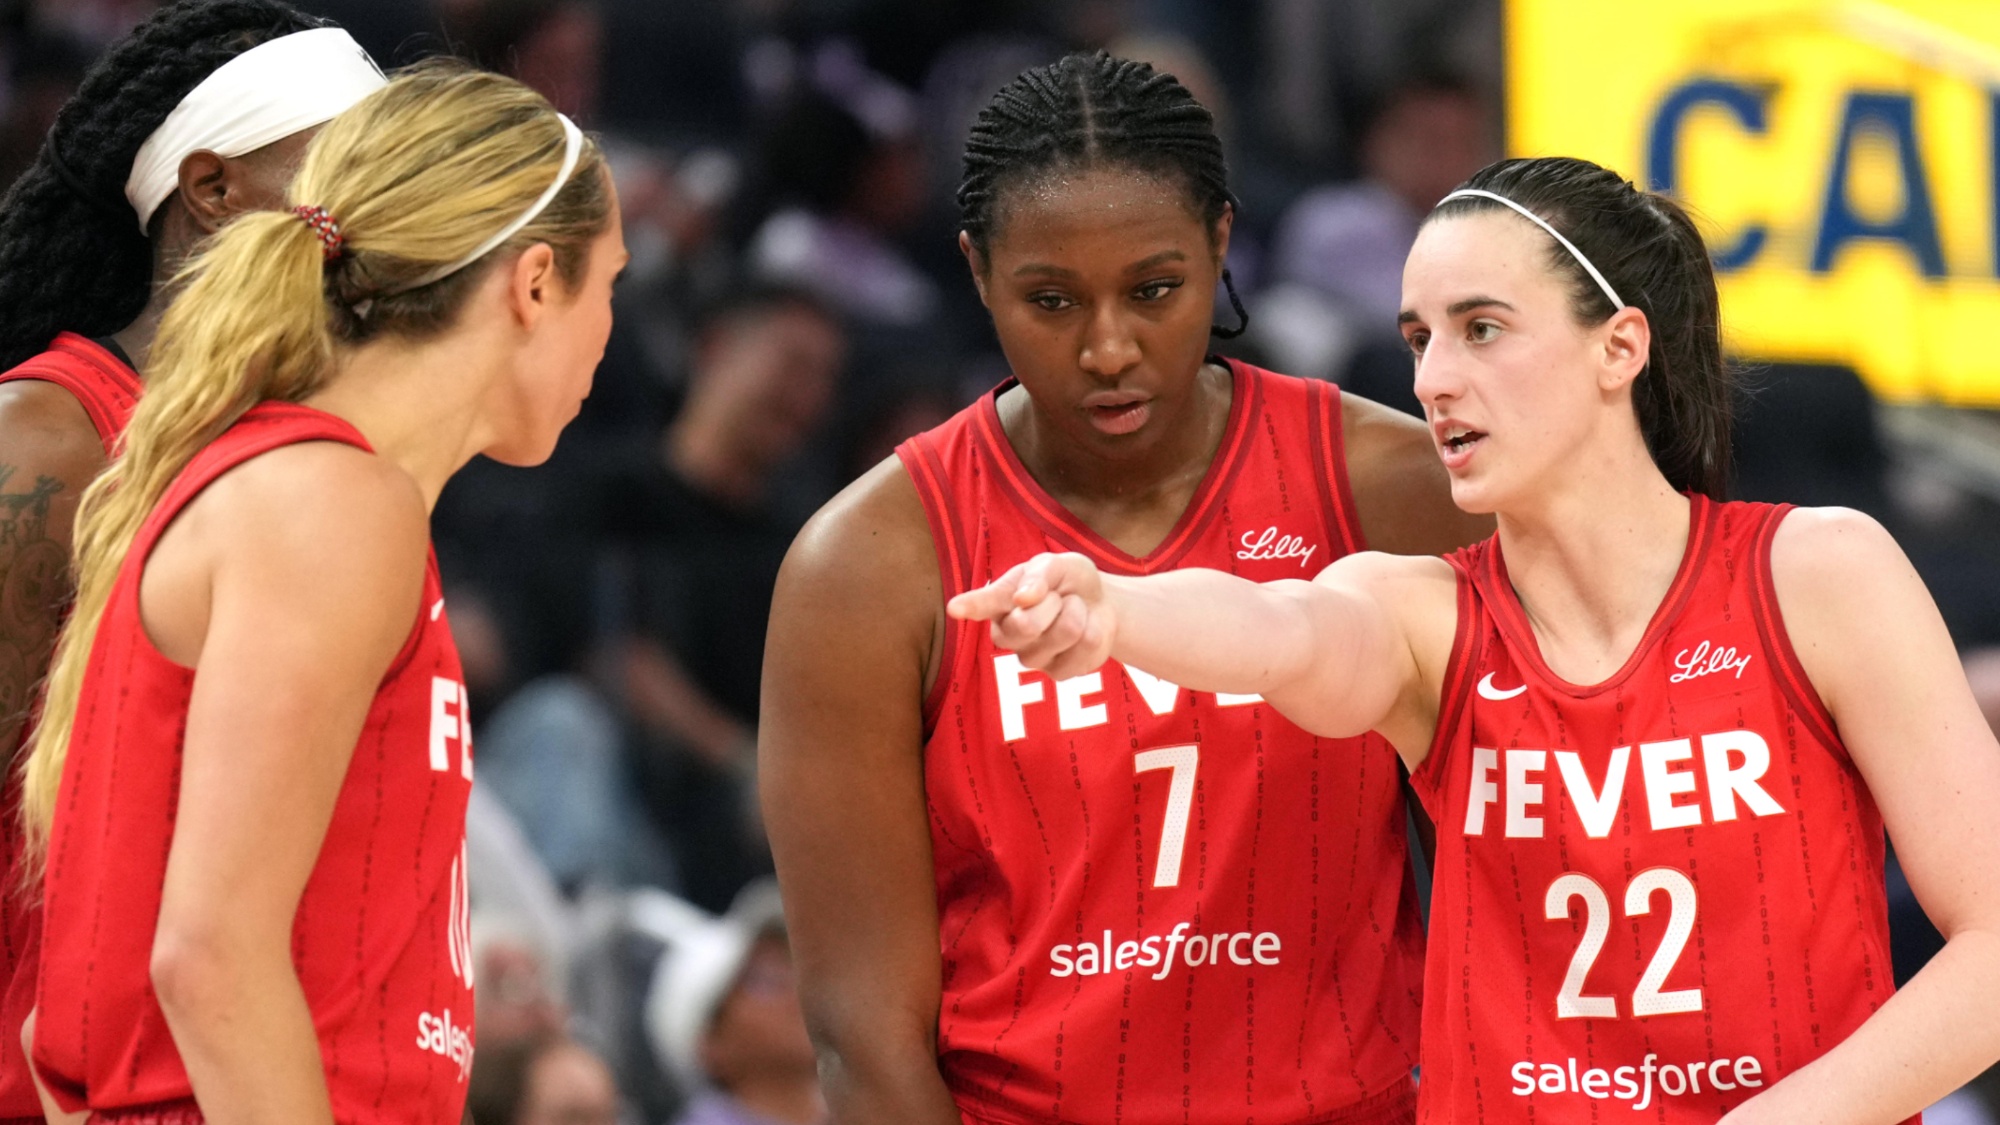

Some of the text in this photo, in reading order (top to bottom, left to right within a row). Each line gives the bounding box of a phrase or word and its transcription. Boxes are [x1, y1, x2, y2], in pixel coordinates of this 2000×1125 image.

[1649, 78, 2000, 278] CA
[1236, 526, 1317, 567] Lilly
[1669, 640, 1752, 683] Lilly
[993, 654, 1266, 742] FEV
[1310, 770, 1319, 822] 2020
[1463, 729, 1786, 840] FEVER
[1134, 744, 1200, 889] 7
[1310, 834, 1320, 885] 1972
[1752, 833, 1765, 883] 2012
[1759, 894, 1770, 945] 2020
[1049, 922, 1282, 981] salesforce
[1544, 866, 1704, 1020] 22
[1119, 1019, 1130, 1043] ME
[1182, 1021, 1191, 1074] 2009
[1511, 1053, 1763, 1111] salesforce
